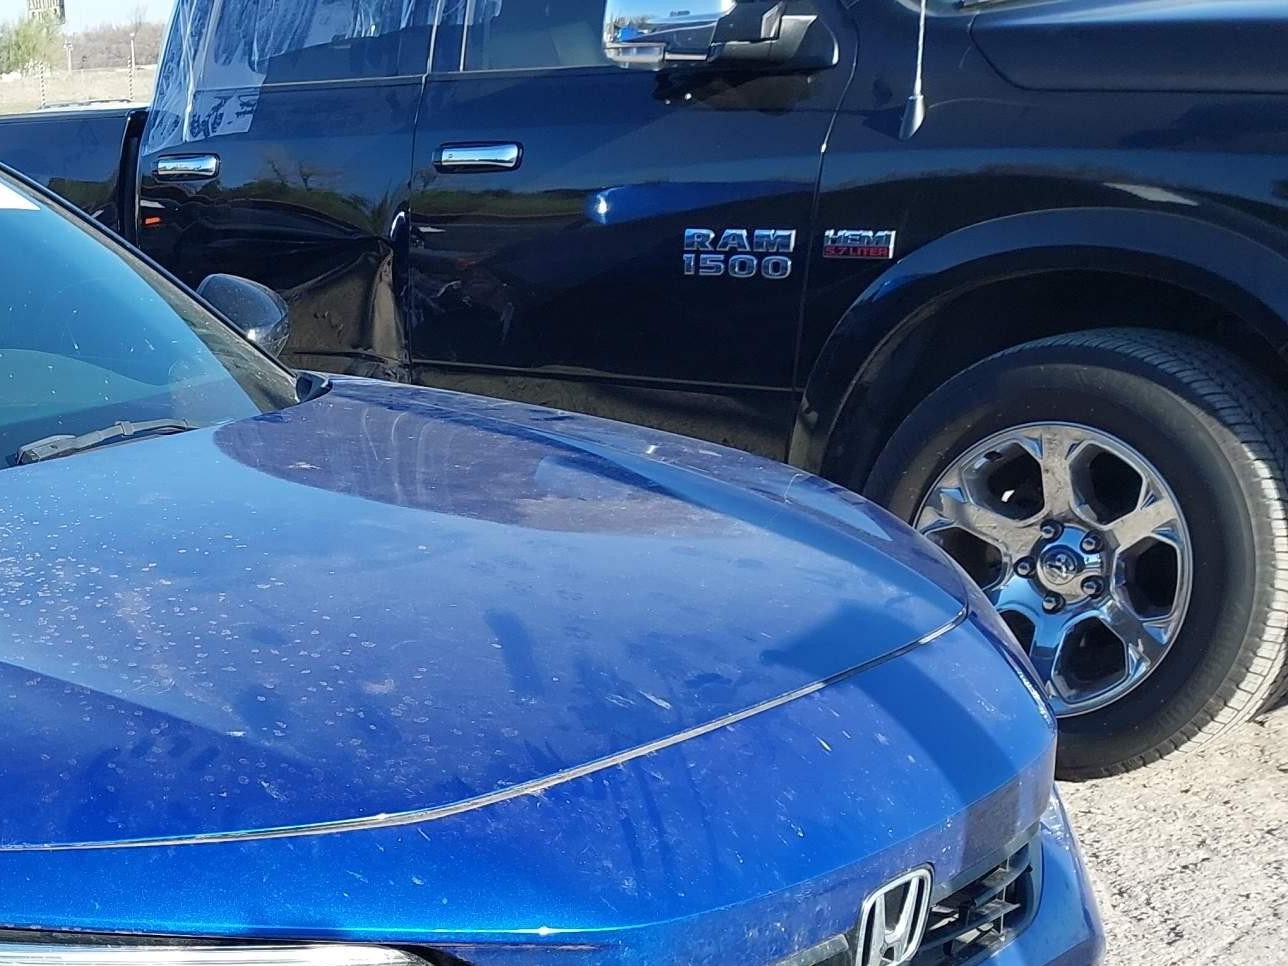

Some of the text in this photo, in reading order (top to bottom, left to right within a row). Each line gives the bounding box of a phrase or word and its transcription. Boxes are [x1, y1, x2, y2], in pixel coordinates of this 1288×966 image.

[683, 228, 797, 252] RAM
[824, 229, 896, 246] HEMI
[683, 253, 792, 279] 1500
